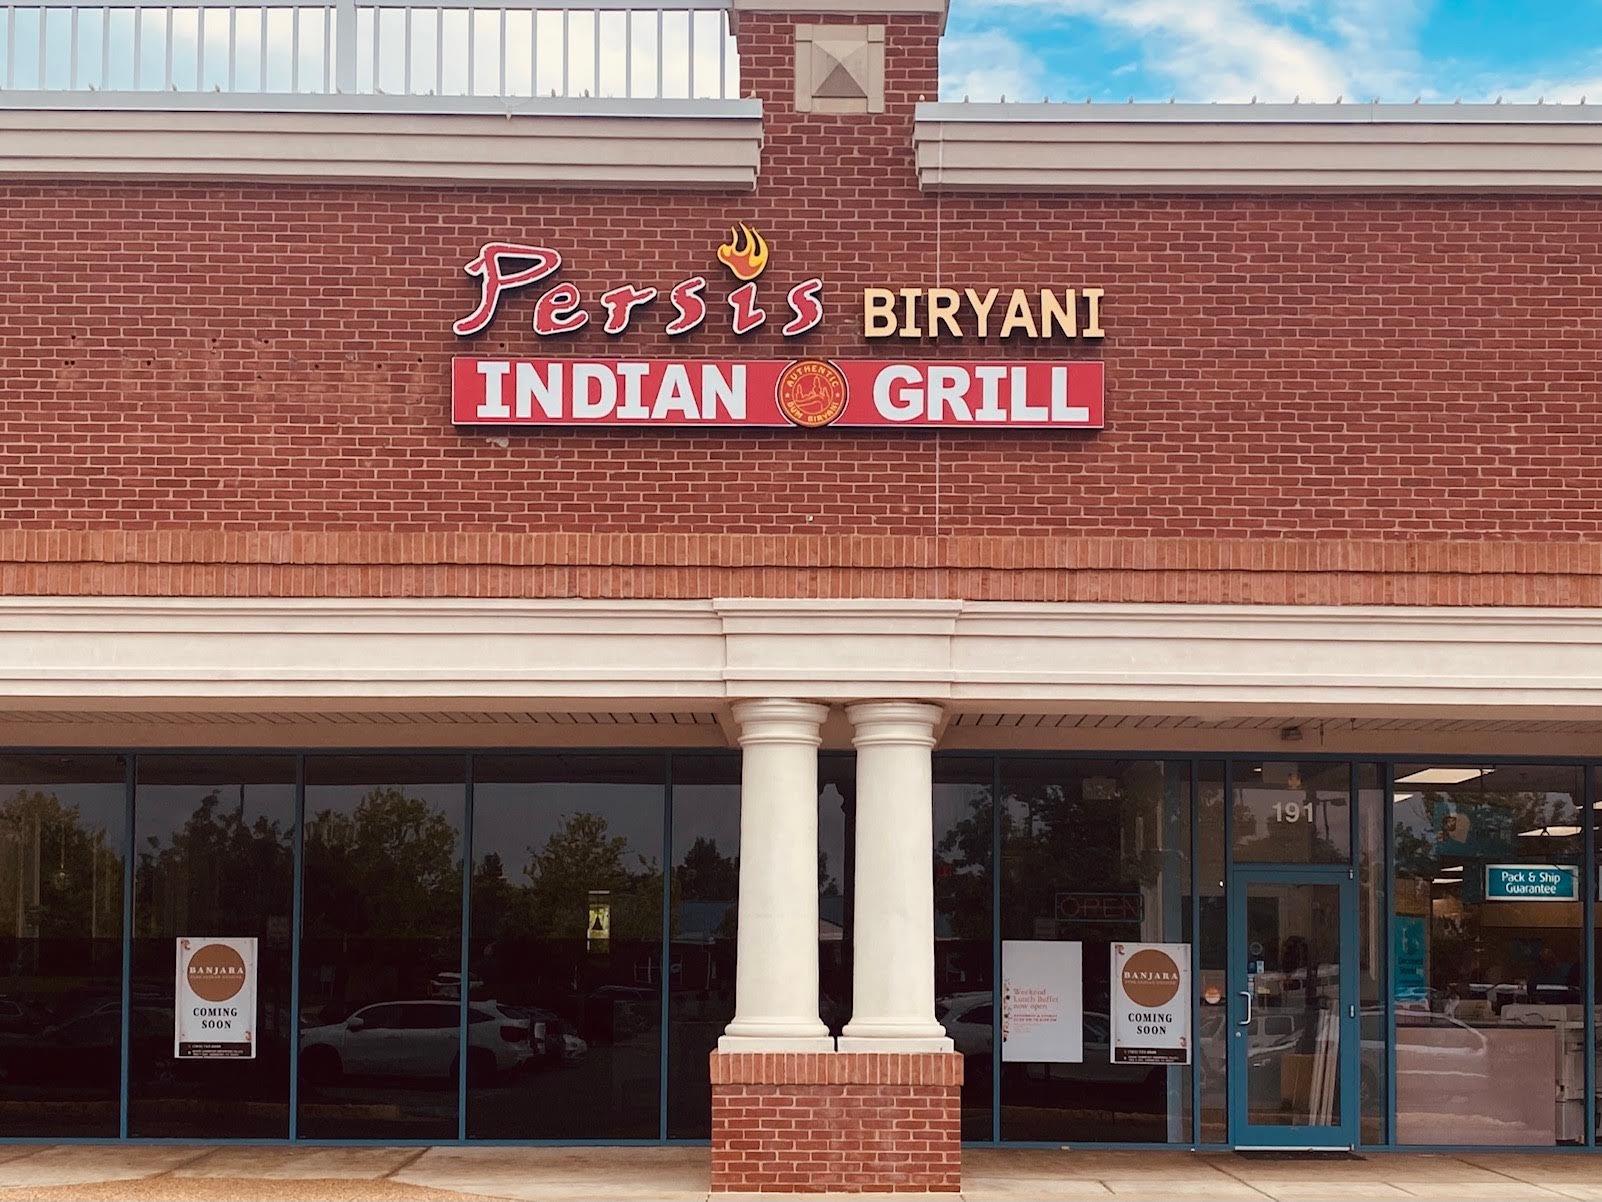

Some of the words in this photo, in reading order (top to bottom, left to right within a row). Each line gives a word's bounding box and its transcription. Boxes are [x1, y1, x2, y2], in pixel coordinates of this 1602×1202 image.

[453, 241, 823, 337] Persis
[863, 287, 1106, 338] BIRYANI
[787, 365, 839, 387] AUTHENTIC
[476, 361, 747, 420] INDIAN
[873, 364, 1090, 423] GRILL
[787, 401, 804, 419] DUM
[807, 402, 839, 422] BIRYANI
[1272, 802, 1313, 822] 191
[1501, 871, 1525, 882] Pack
[1528, 872, 1536, 883] &
[1539, 872, 1560, 885] Ship
[1506, 883, 1557, 894] Guarantee
[1061, 897, 1139, 917] OPEN
[190, 967, 243, 975] BANJARA
[1124, 971, 1178, 980] BANJARA
[193, 1008, 238, 1017] COMING
[1128, 1013, 1172, 1023] COMING
[202, 1020, 231, 1029] SOON
[1136, 1026, 1166, 1035] SOON
